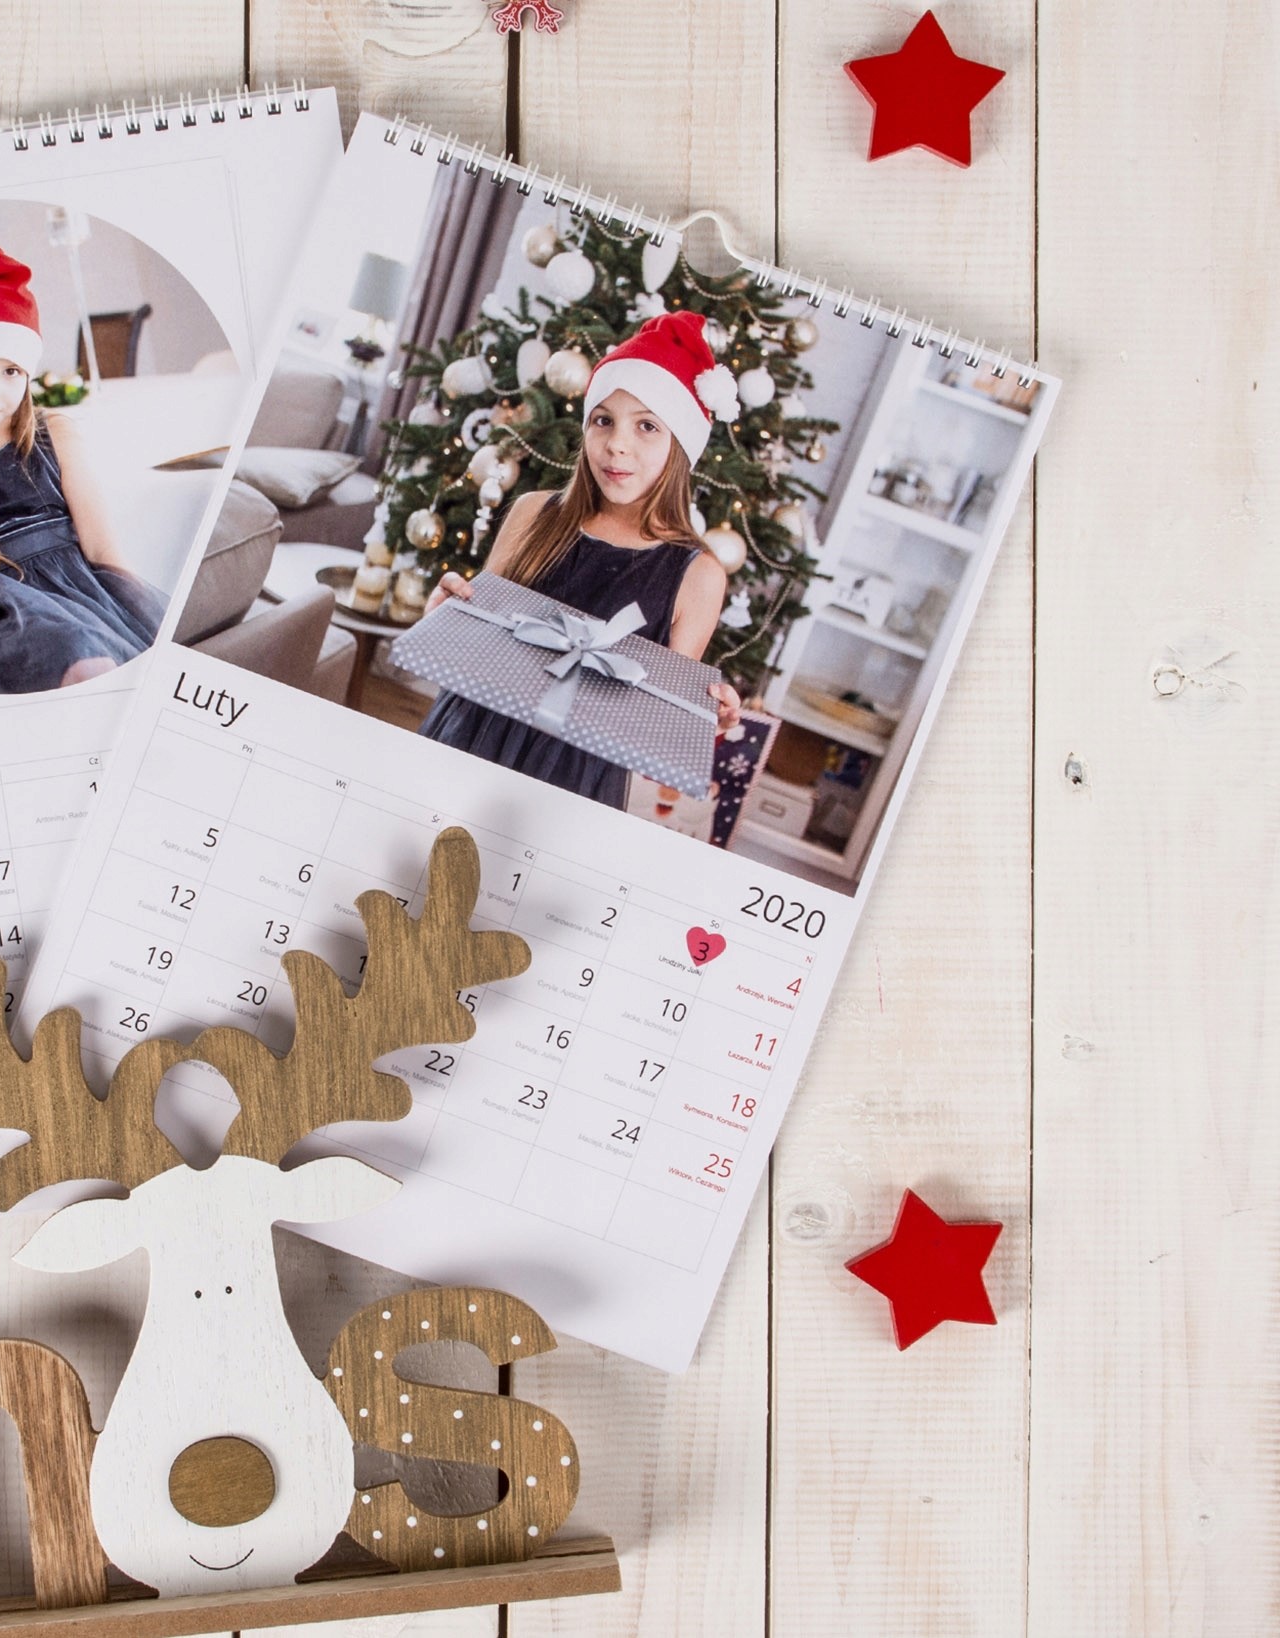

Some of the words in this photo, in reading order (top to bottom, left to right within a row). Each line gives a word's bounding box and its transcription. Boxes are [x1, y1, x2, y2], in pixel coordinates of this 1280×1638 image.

[172, 671, 248, 727] Luty
[241, 744, 252, 753] Pn
[524, 850, 534, 859] Cz
[709, 919, 719, 929] So
[202, 827, 219, 847] 5
[298, 863, 313, 882] 6
[578, 967, 593, 987] 9
[662, 998, 686, 1022] 10
[754, 1033, 776, 1056] 11
[512, 873, 521, 891] 1
[600, 907, 616, 927] 2
[693, 941, 709, 961] 3
[786, 977, 801, 996] 4
[658, 956, 686, 971] Urodziny
[740, 886, 825, 938] 2020
[119, 1006, 150, 1032] 26
[147, 946, 172, 969] 19
[236, 980, 267, 1006] 20
[424, 1049, 454, 1076] 22
[517, 1084, 548, 1109] 23
[610, 1119, 640, 1143] 24
[703, 1153, 733, 1177] 25
[170, 884, 195, 910] 12
[264, 920, 289, 944] 13
[545, 1024, 571, 1049] 16
[639, 1059, 665, 1081] 17
[731, 1093, 756, 1117] 18
